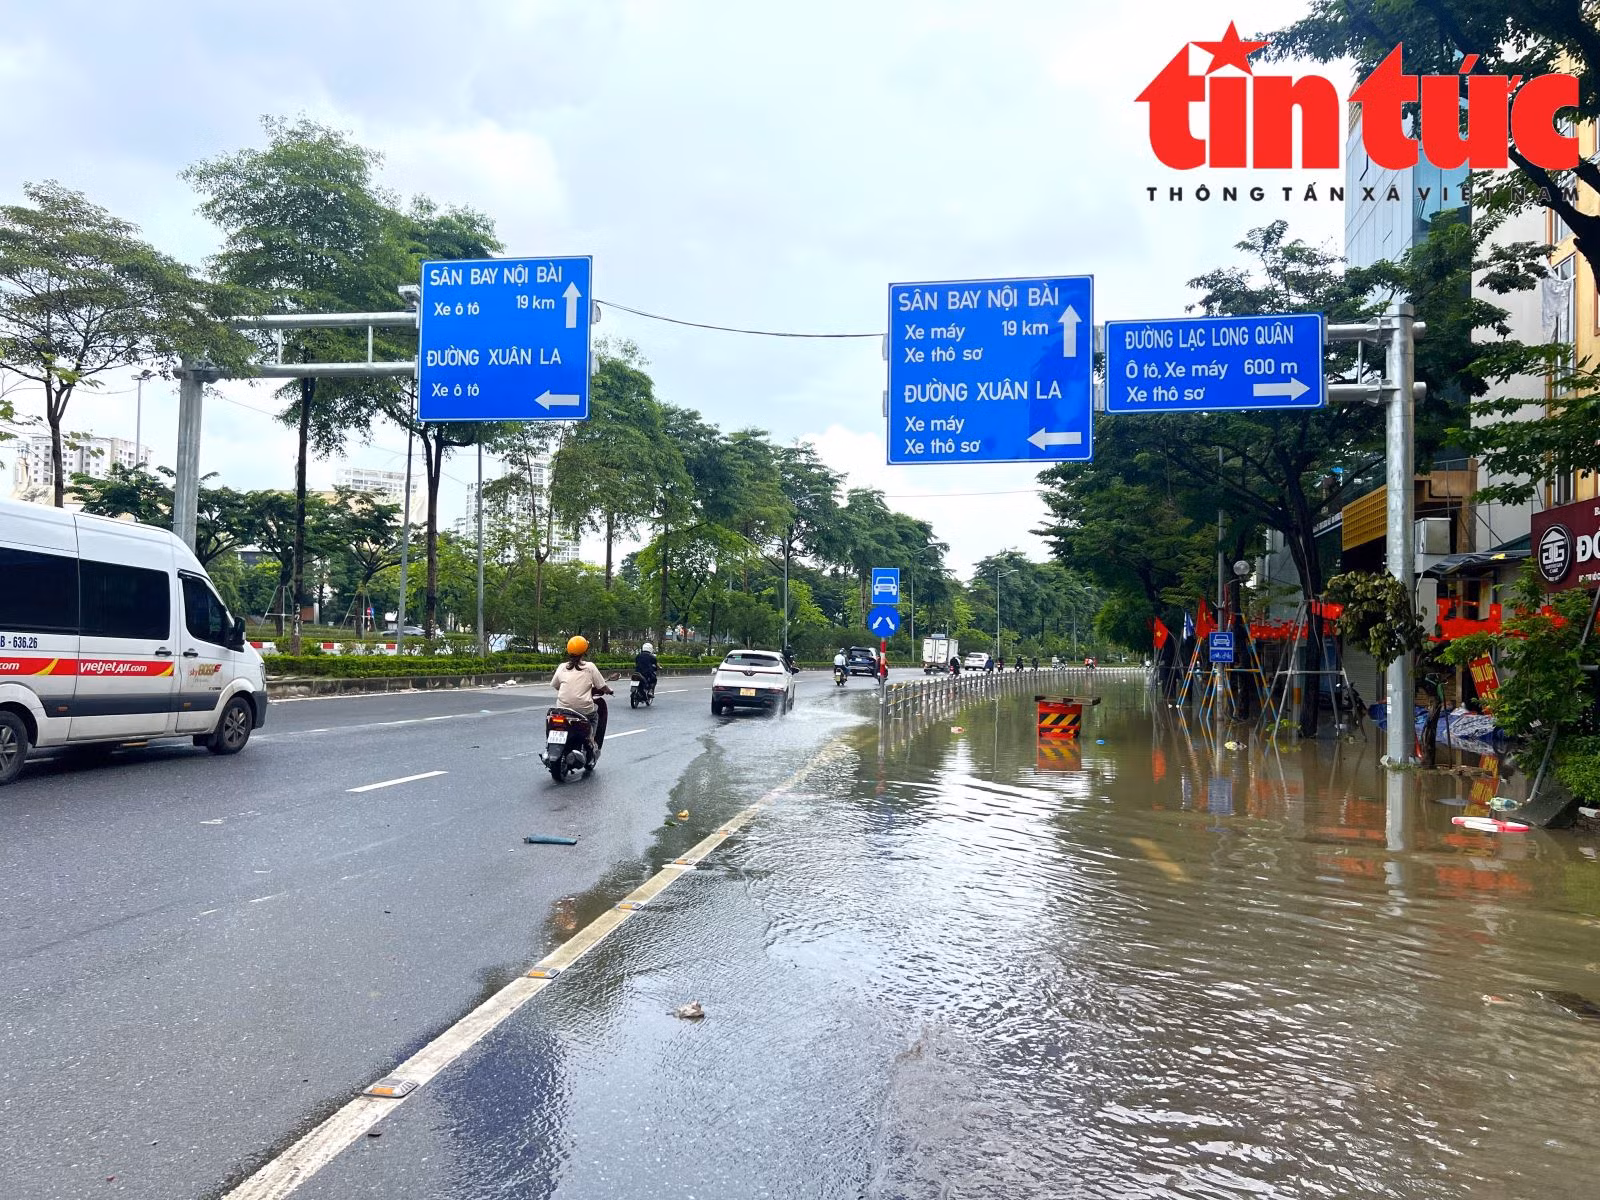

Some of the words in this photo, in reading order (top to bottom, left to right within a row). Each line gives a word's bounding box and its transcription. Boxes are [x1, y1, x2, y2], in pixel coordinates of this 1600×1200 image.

[430, 267, 462, 286] SÂN
[471, 268, 498, 285] BAY
[503, 264, 528, 287] NỘI
[536, 262, 562, 283] BÀI
[516, 295, 529, 309] 19
[533, 296, 555, 310] km
[899, 289, 938, 311] SÂN
[948, 290, 981, 310] BAY
[988, 285, 1018, 311] NỘI
[1028, 282, 1059, 307] BÀI
[434, 302, 451, 316] Xe
[455, 302, 463, 315] ô
[467, 302, 480, 315] tô
[905, 324, 925, 340] Xe
[931, 323, 966, 342] máy
[1002, 320, 1017, 336] 19
[1022, 320, 1049, 336] km
[1125, 325, 1174, 350] ĐƯỜNG
[1179, 328, 1206, 352] LẠC
[1212, 327, 1249, 347] LONG
[1255, 322, 1294, 345] QUÂN
[427, 345, 480, 367] ĐƯỜNG
[488, 346, 532, 365] XUÂN
[540, 348, 562, 364] LA
[905, 347, 925, 363] Xe
[931, 347, 956, 362] thô
[963, 347, 983, 361] sơ
[1126, 360, 1139, 379] Ô
[1164, 361, 1186, 377] Xe
[1191, 360, 1229, 380] máy
[1244, 359, 1275, 375] 600
[1280, 361, 1298, 375] m
[432, 382, 449, 397] Xe
[454, 383, 462, 396] ô
[467, 383, 480, 396] tô
[904, 378, 968, 403] ĐƯỜNG
[976, 378, 1028, 401] XUÂN
[1036, 380, 1062, 399] LA
[1127, 386, 1148, 403] Xe
[1153, 386, 1179, 402] thô
[1184, 386, 1206, 401] sơ
[905, 416, 925, 432] Xe
[931, 415, 965, 434] máy
[905, 438, 925, 454] Xe
[931, 438, 956, 454] thô
[960, 439, 981, 453] sơ
[13, 636, 38, 649] 636.26
